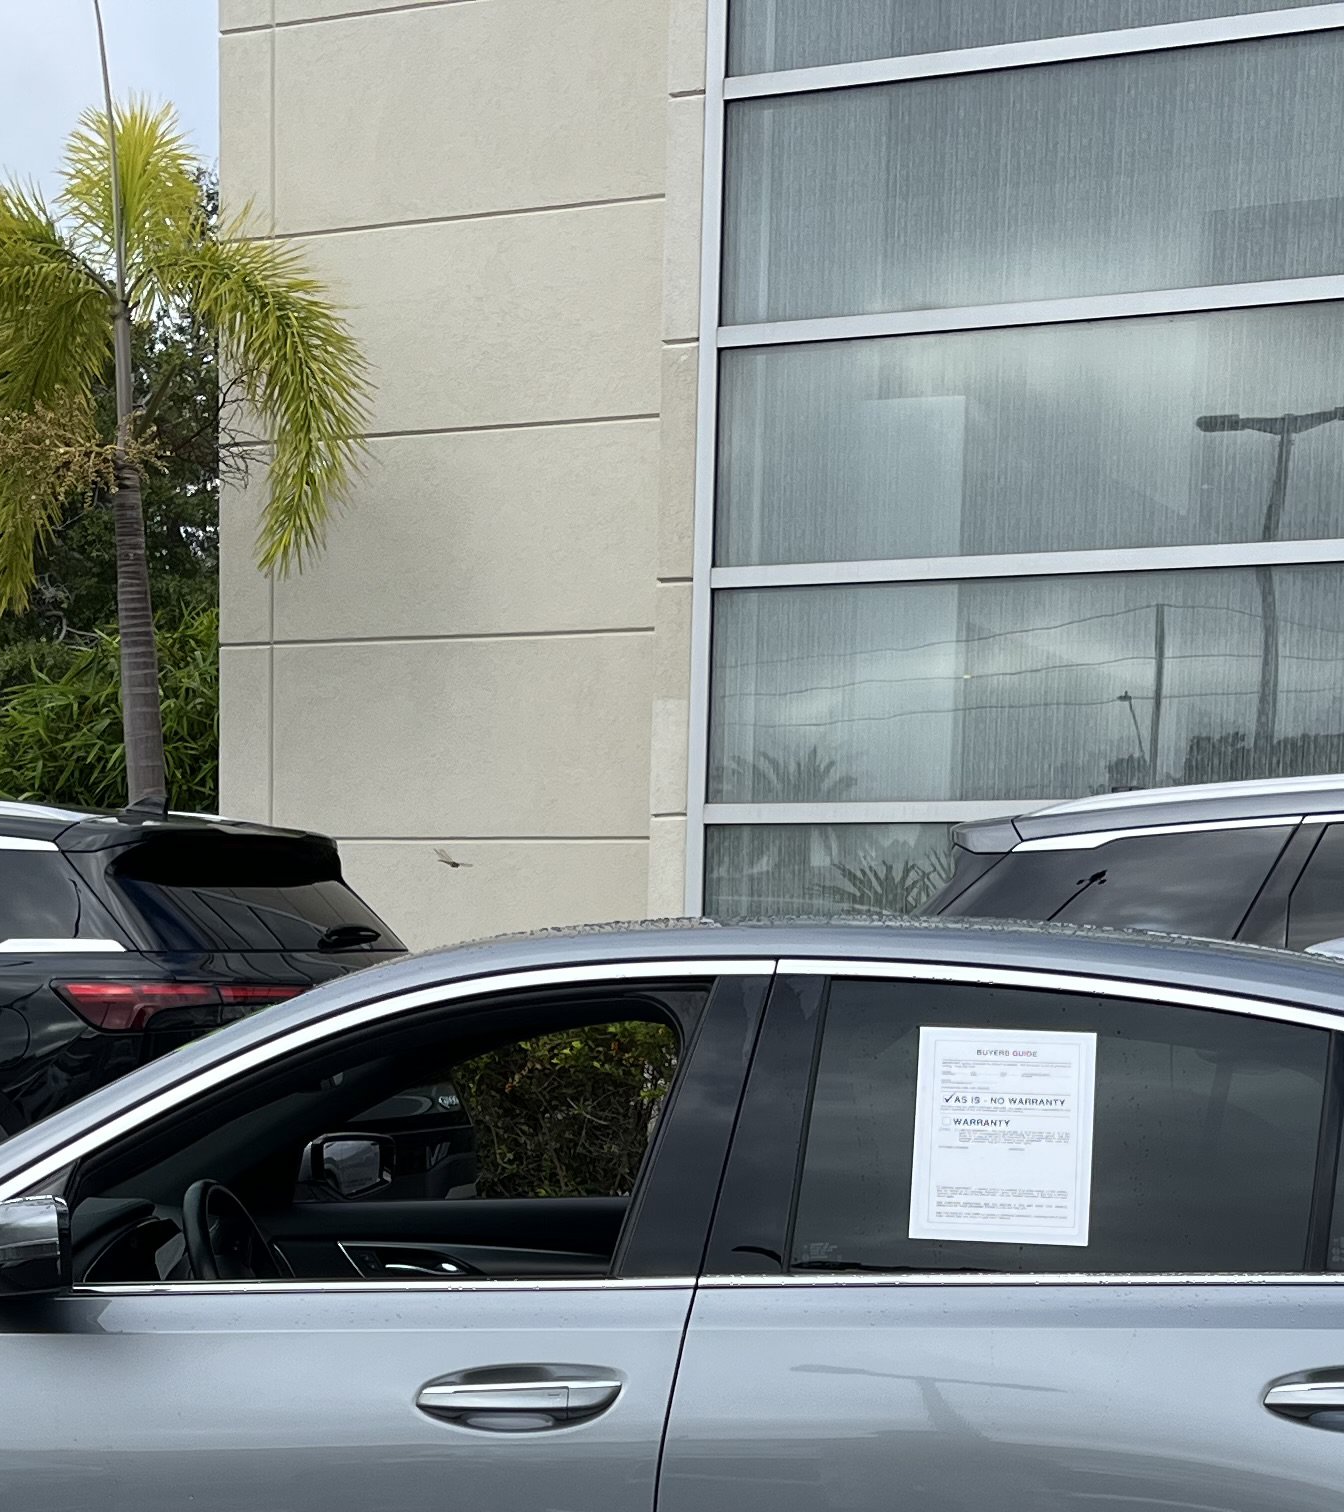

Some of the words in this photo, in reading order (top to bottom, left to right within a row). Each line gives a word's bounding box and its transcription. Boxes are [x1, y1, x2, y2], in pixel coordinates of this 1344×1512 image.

[1012, 1050, 1038, 1058] GUIDE
[954, 1096, 967, 1104] AS
[990, 1096, 1005, 1105] NO
[1008, 1097, 1065, 1107] WARRANTY
[953, 1118, 1010, 1127] WARRANTY
